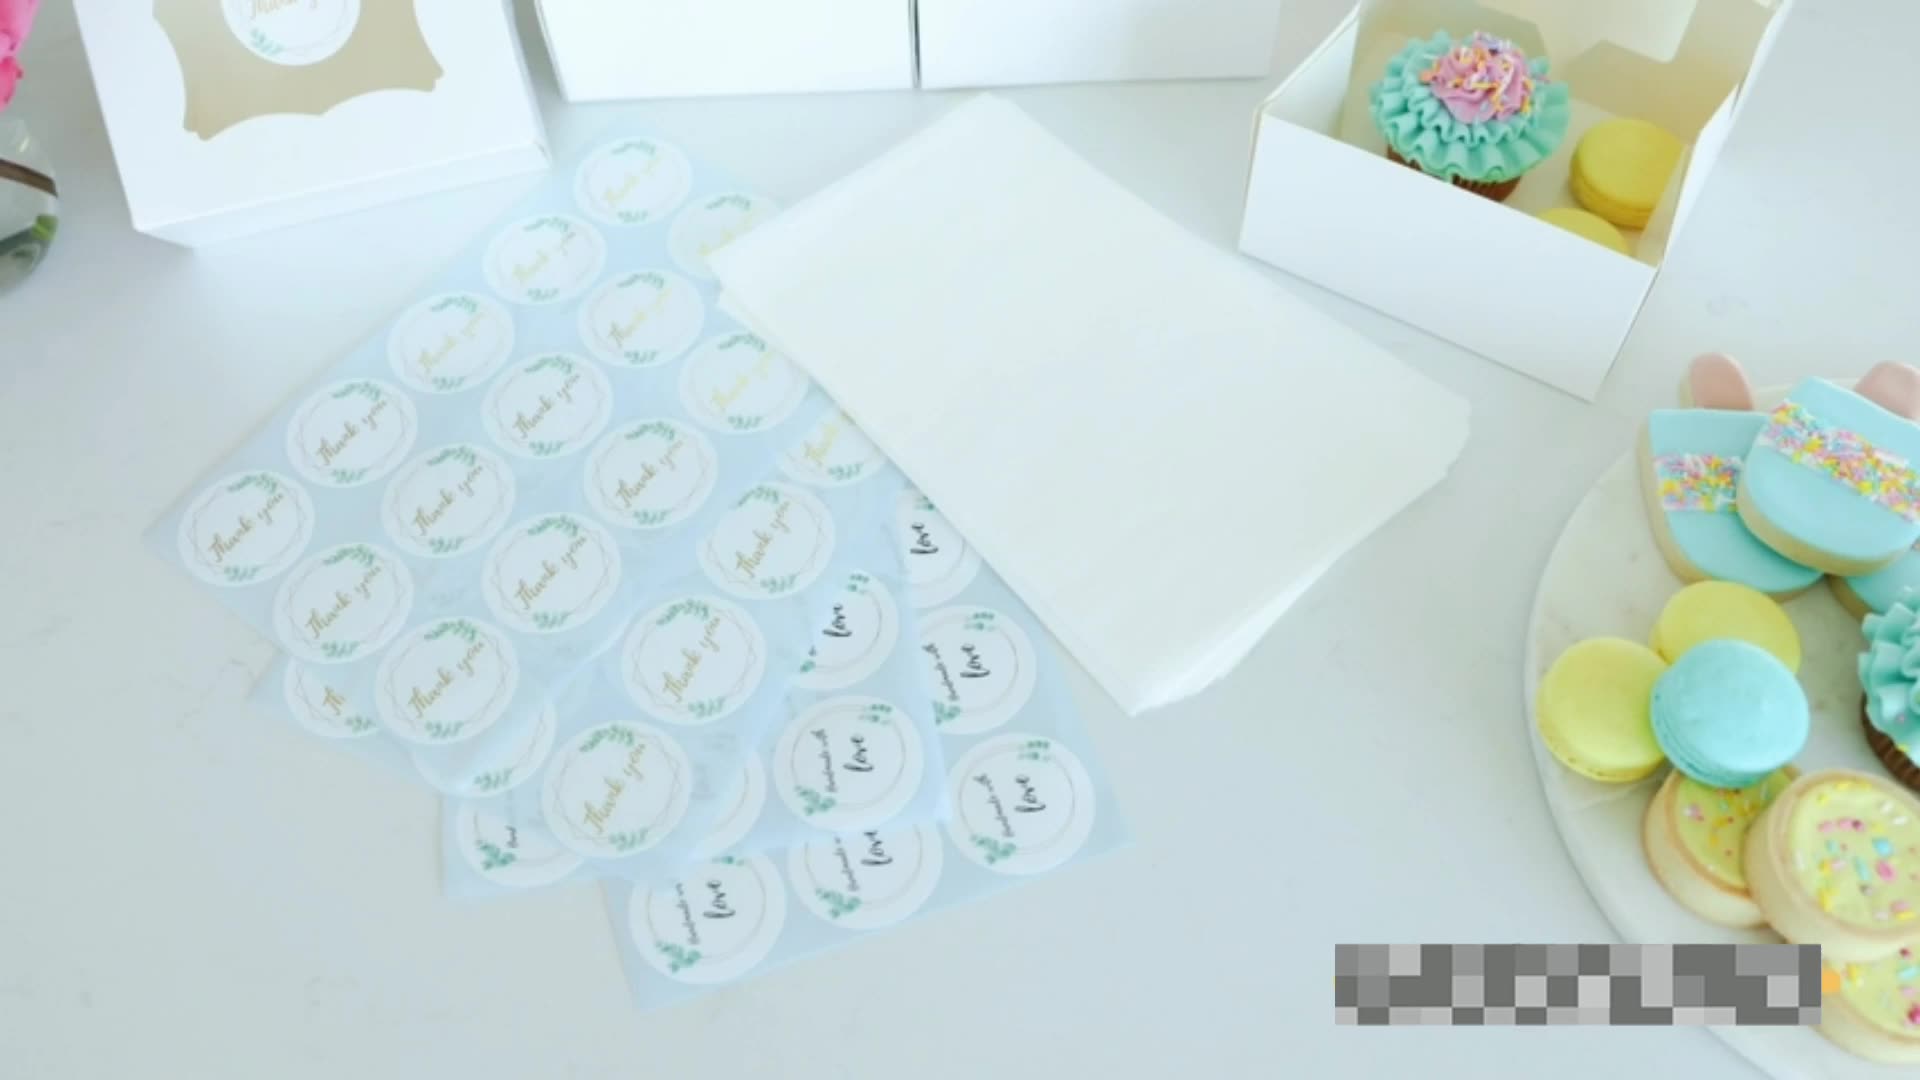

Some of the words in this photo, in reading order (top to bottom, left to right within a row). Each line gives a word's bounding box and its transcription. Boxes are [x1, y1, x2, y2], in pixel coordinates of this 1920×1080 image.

[512, 395, 555, 440] Thank
[315, 420, 361, 466] Thank
[615, 461, 659, 509] Thank
[411, 487, 456, 537] Thank
[207, 515, 254, 563] Thank
[735, 527, 773, 580] Thank
[910, 523, 939, 554] love
[514, 558, 560, 610] Thank
[561, 535, 588, 570] you
[305, 589, 352, 640] Thank
[821, 603, 853, 638] love
[662, 647, 703, 703] Thank
[959, 643, 992, 679] love
[408, 667, 455, 719] Thank
[842, 732, 876, 773] love
[583, 775, 627, 834] Thank
[623, 743, 647, 782] you
[1013, 774, 1047, 813] love
[703, 879, 736, 919] love
